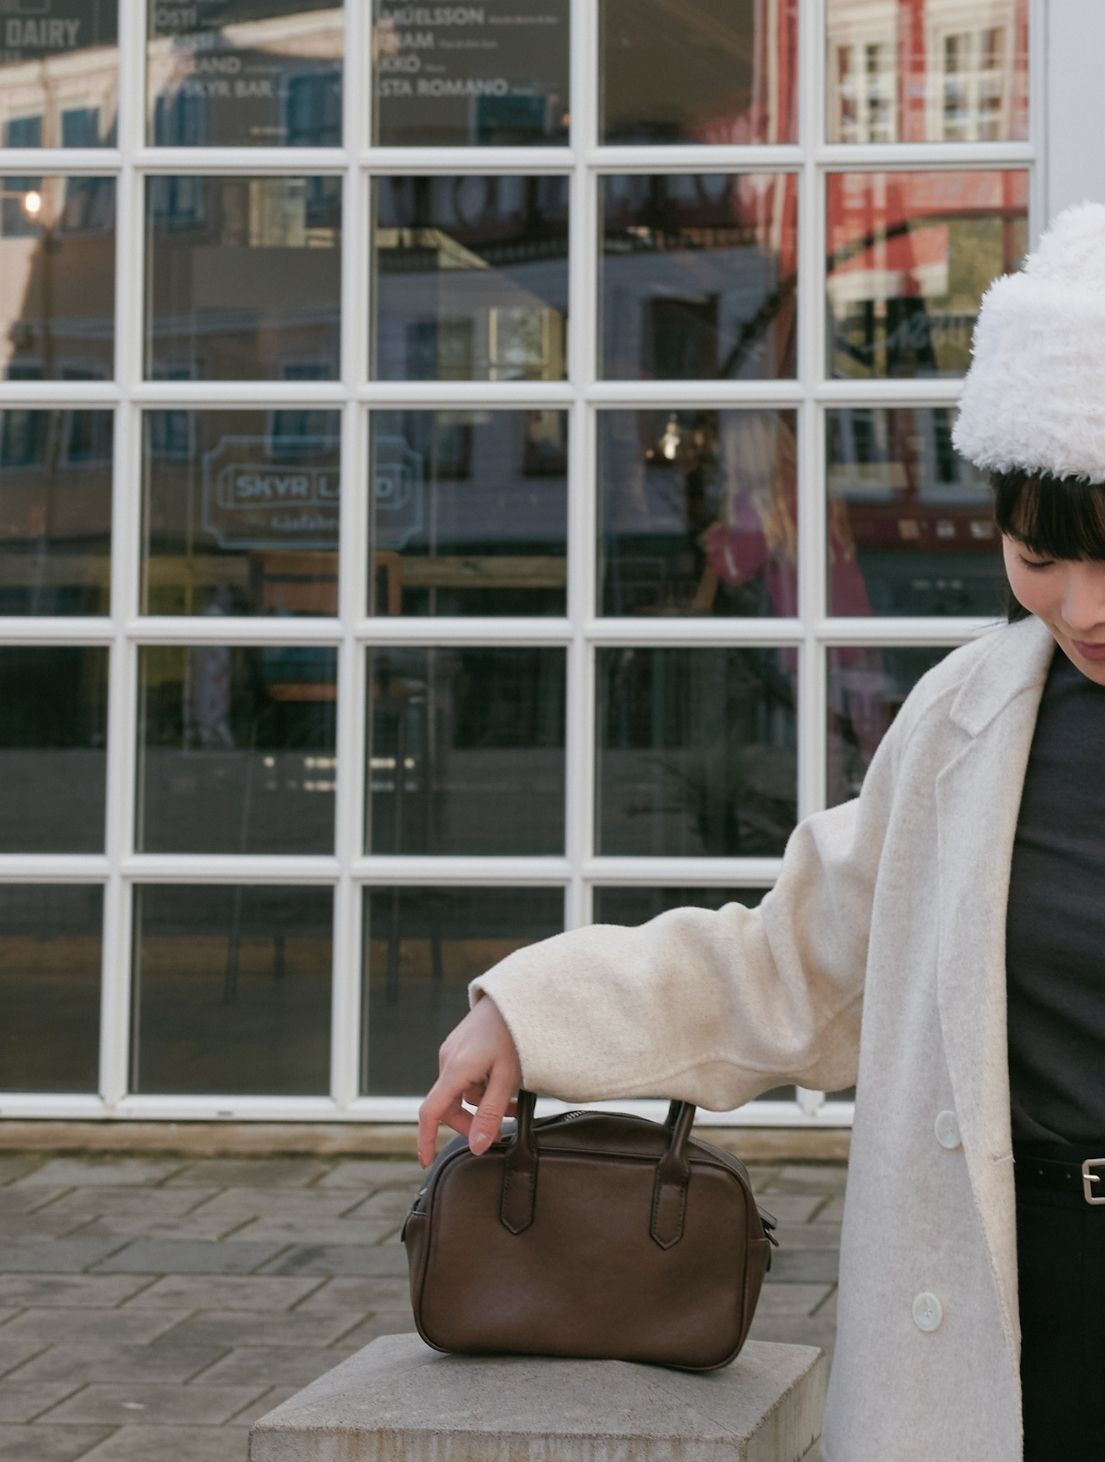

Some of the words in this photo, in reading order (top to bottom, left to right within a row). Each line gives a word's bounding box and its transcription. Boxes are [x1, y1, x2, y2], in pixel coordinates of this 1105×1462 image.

[5, 18, 81, 48] DAIRY
[417, 78, 509, 96] ROMANO
[236, 474, 309, 498] SKYR
